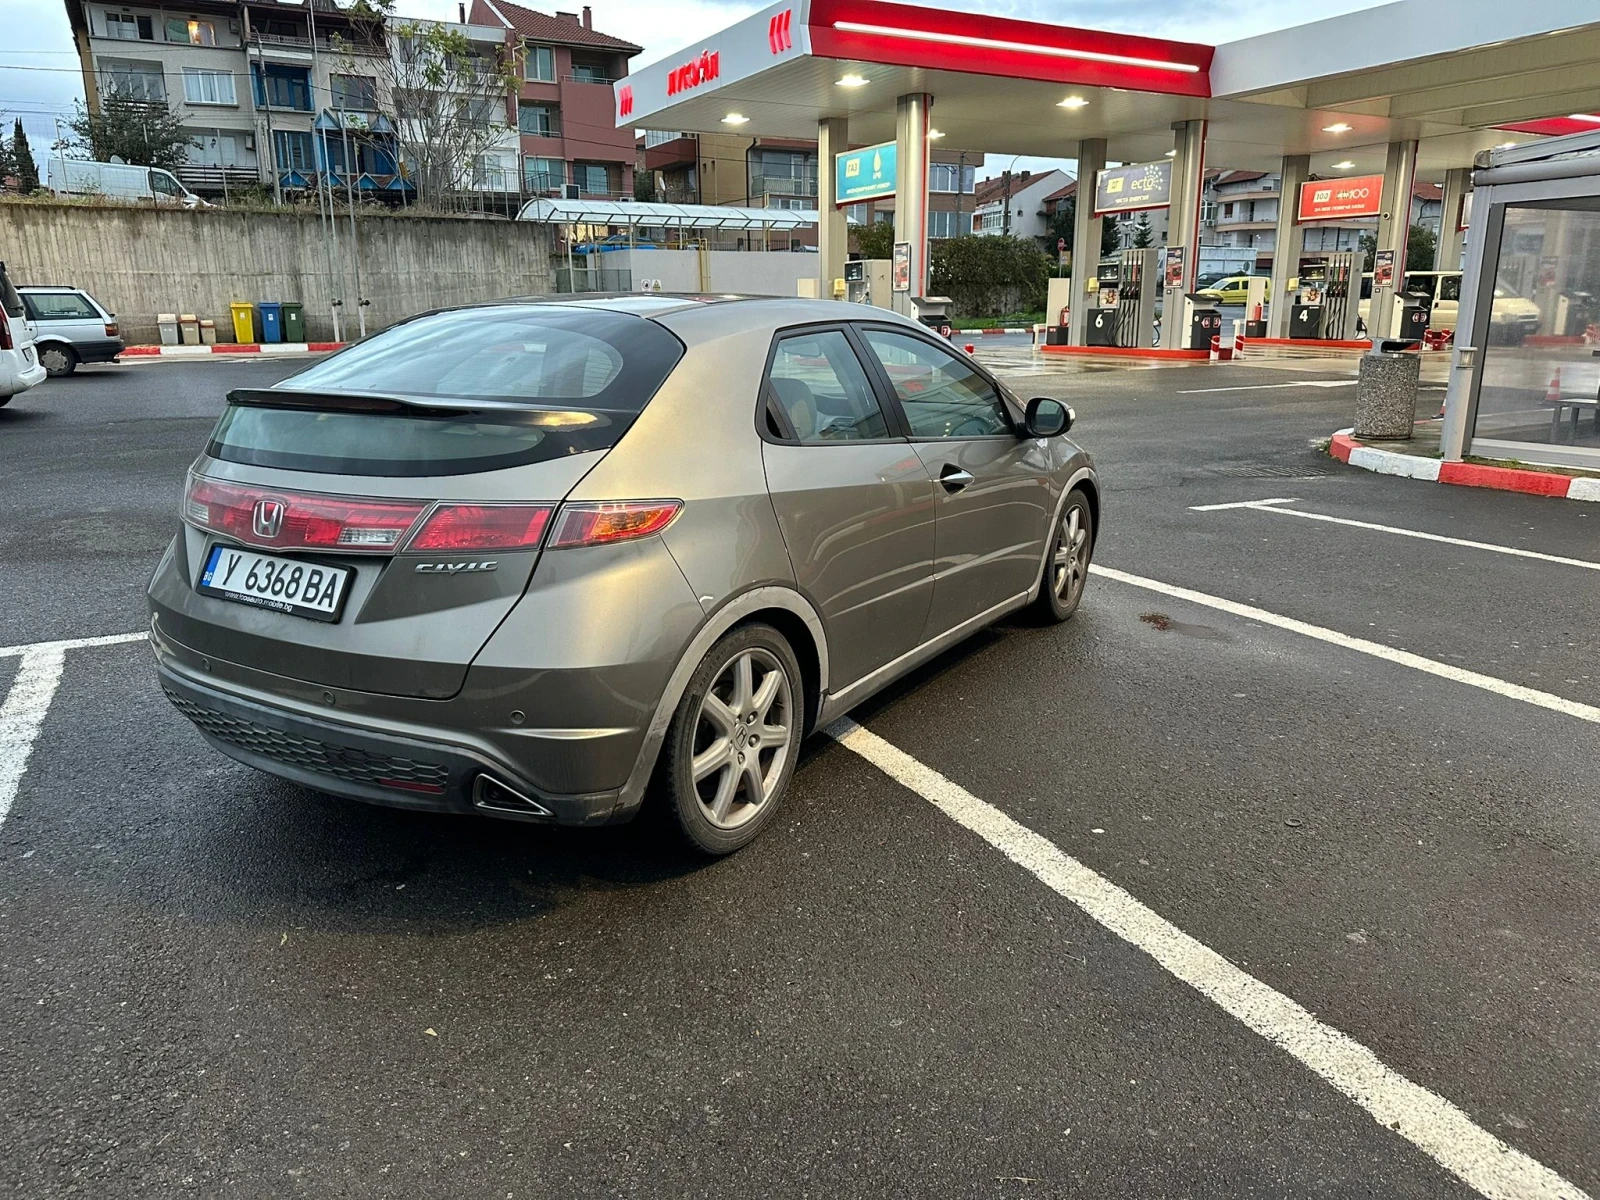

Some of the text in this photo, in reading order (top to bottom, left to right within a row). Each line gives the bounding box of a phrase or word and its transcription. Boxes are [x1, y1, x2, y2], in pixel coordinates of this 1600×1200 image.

[1131, 176, 1154, 190] ecto
[1316, 192, 1329, 200] 100
[1095, 314, 1103, 328] 6
[1299, 310, 1308, 322] 4
[415, 561, 498, 576] CIVIC
[203, 571, 212, 581] BG
